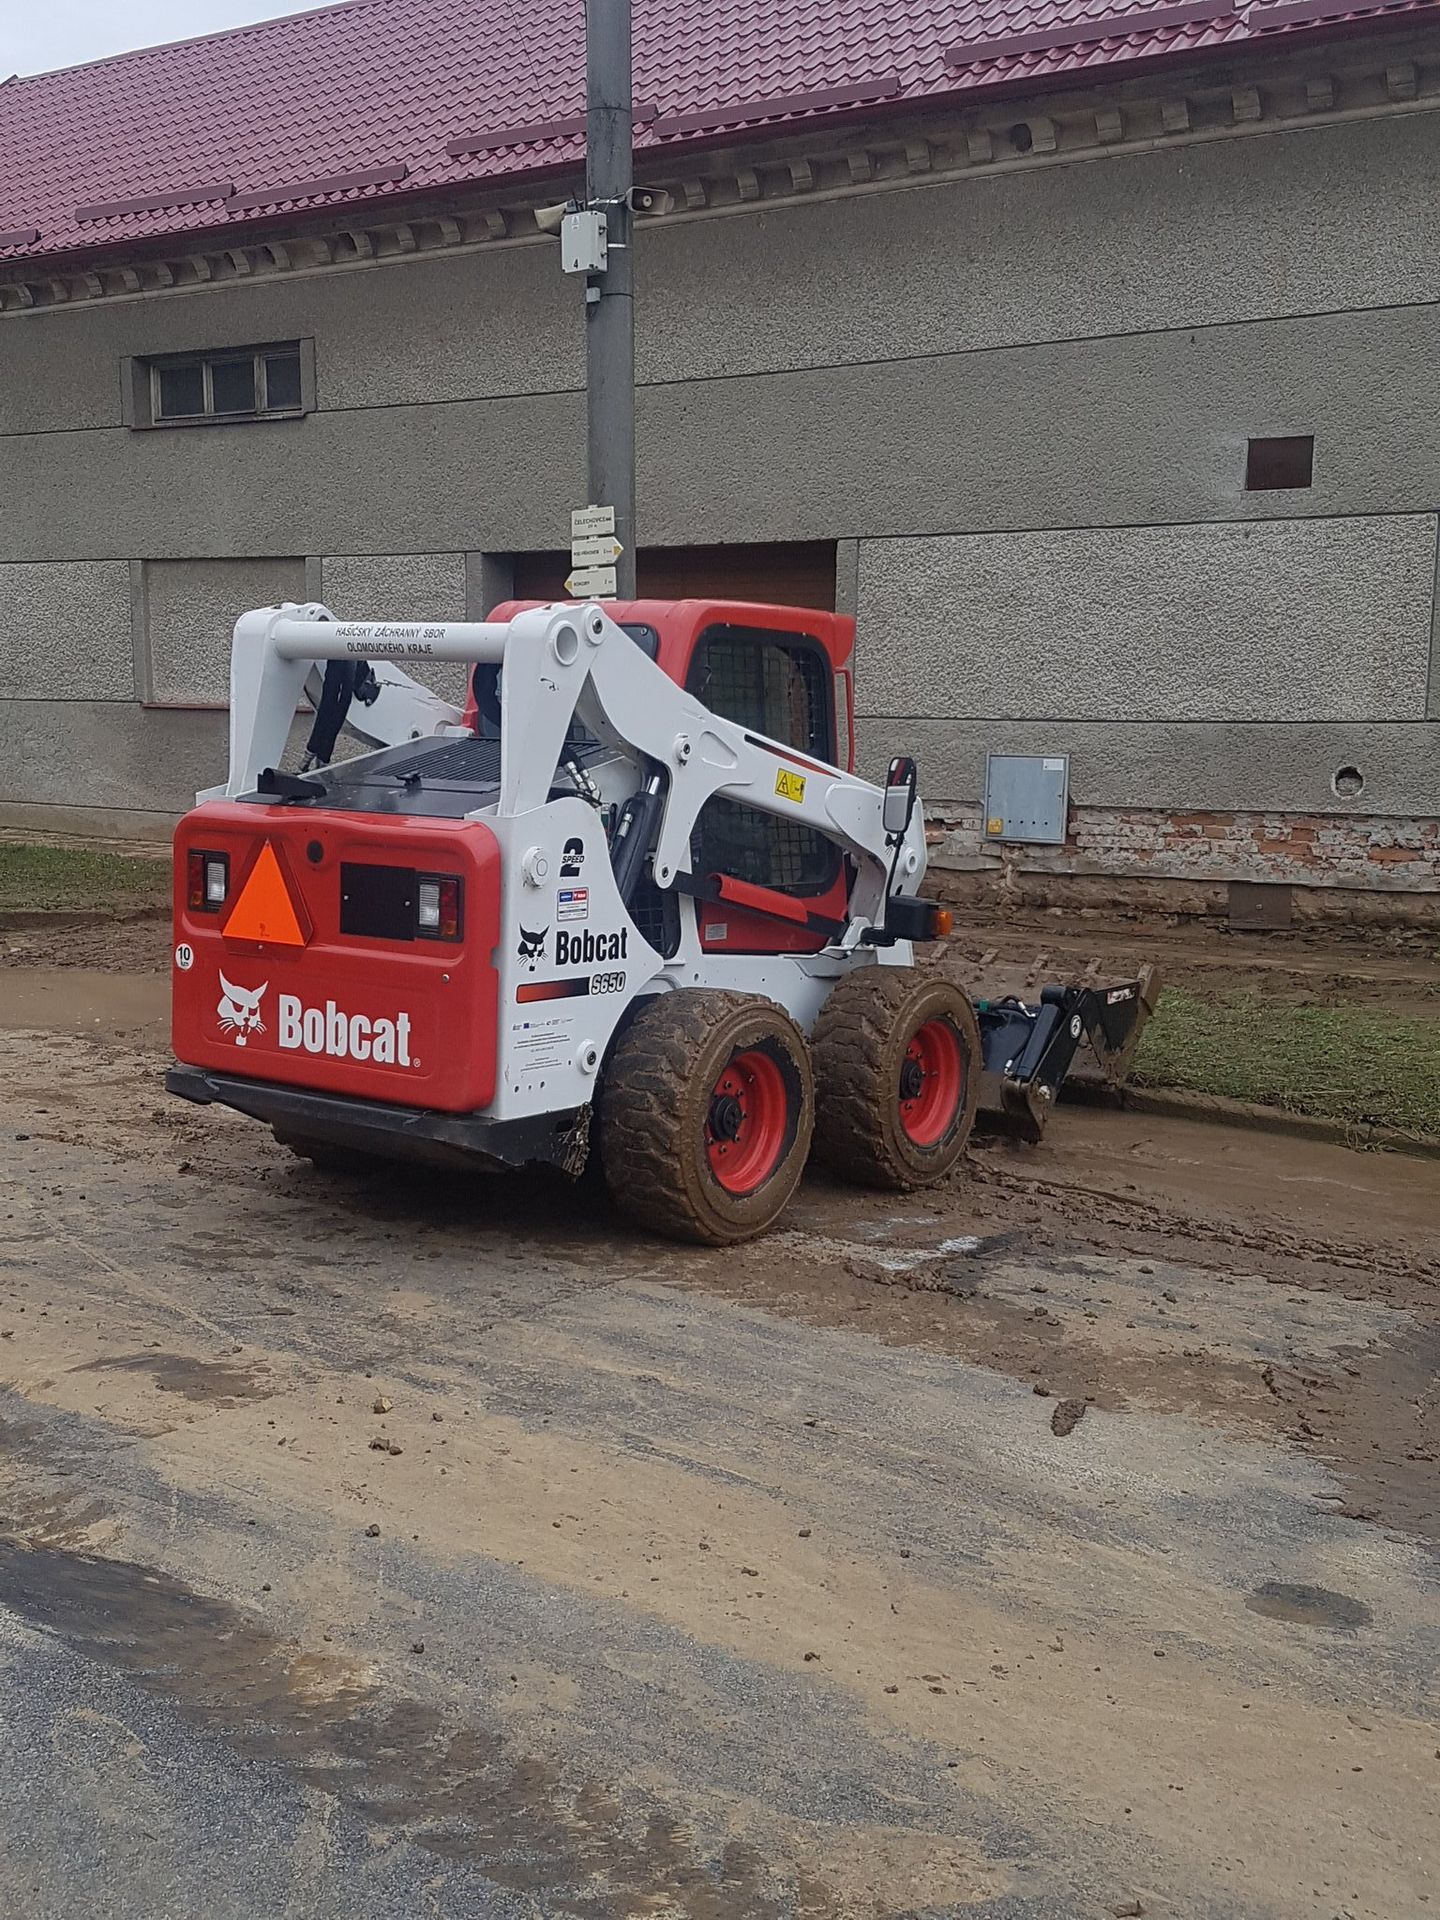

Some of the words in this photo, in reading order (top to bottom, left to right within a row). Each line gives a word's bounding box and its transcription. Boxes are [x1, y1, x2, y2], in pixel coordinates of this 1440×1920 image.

[573, 259, 579, 269] 4
[423, 628, 446, 639] SBOR
[346, 640, 405, 654] OLOMOUCKÉHO
[407, 643, 434, 655] KRAJE
[559, 837, 584, 878] 2
[561, 855, 585, 864] SPEED
[177, 946, 191, 961] 10
[555, 927, 628, 966] Bobcat
[591, 971, 626, 995] S650
[279, 993, 411, 1067] Bobcat
